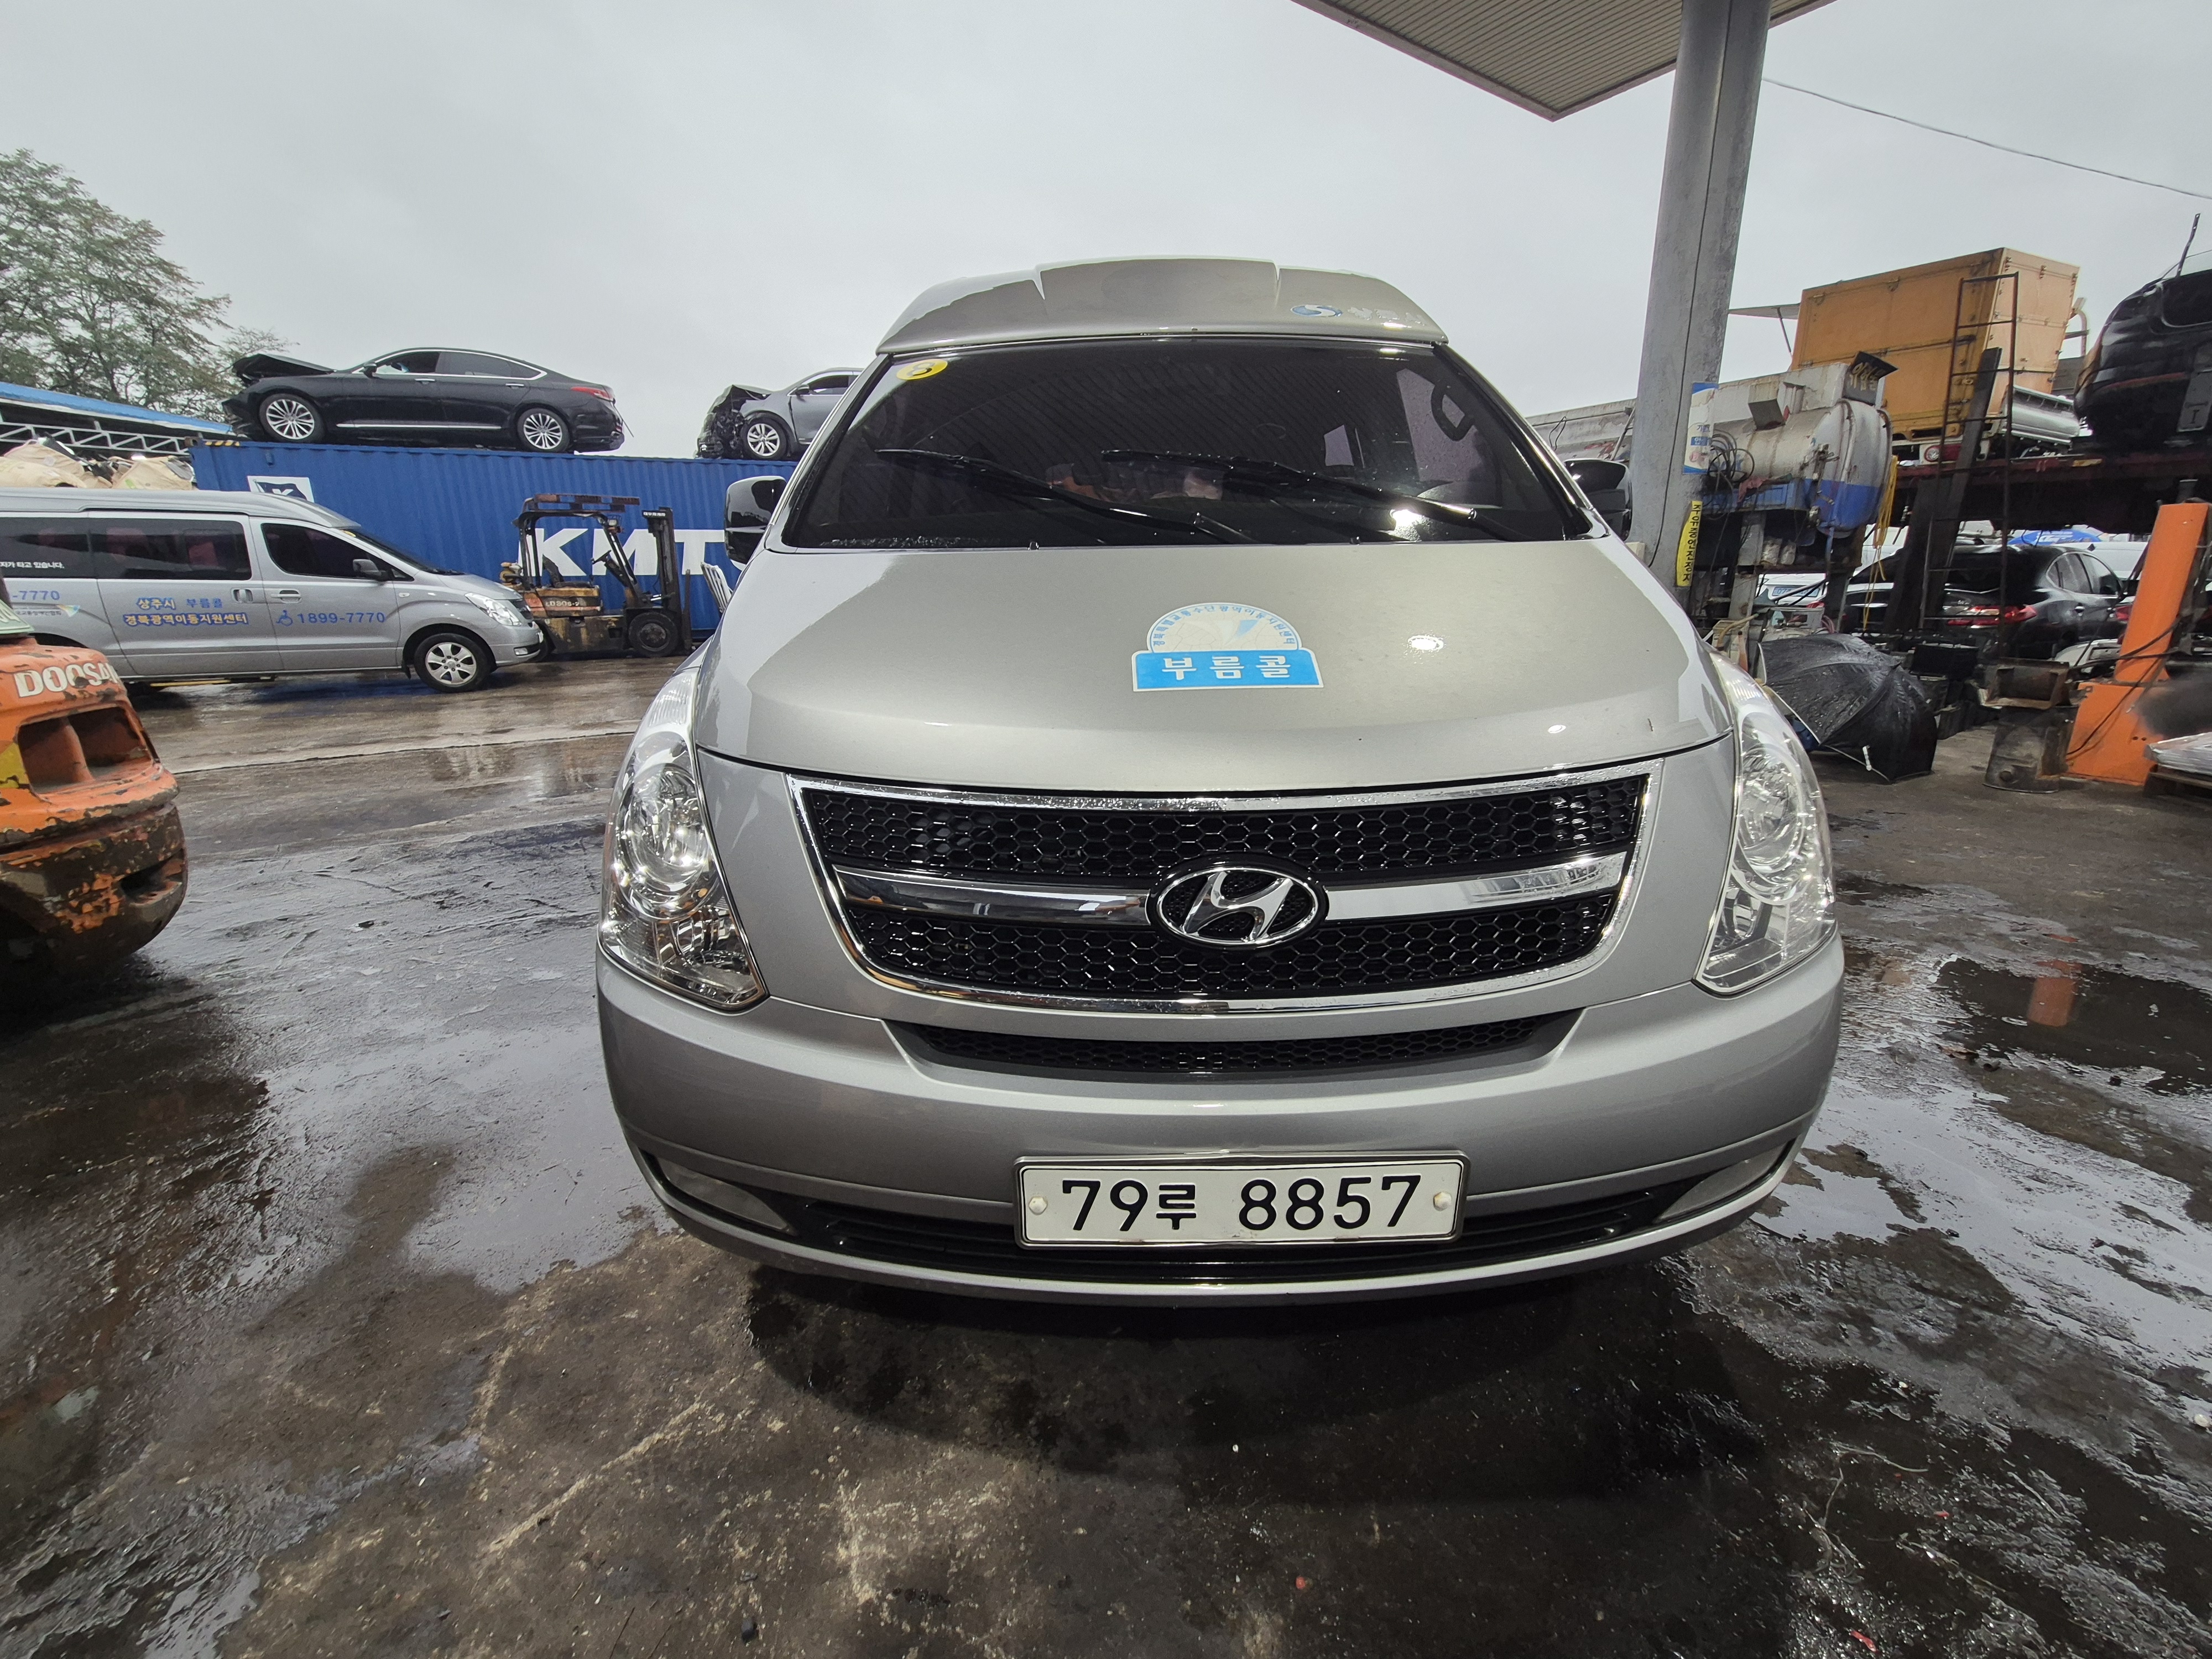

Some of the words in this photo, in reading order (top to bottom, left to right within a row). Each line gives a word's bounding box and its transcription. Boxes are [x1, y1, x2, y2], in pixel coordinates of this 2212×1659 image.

[518, 528, 745, 576] KMT
[137, 597, 176, 610] 상주시
[123, 612, 249, 627] 경북광역이동지원센터
[297, 612, 385, 624] 1899-7770
[1161, 655, 1291, 680] 부름콜
[1062, 1179, 1197, 1232] 79루
[1239, 1174, 1422, 1231] 8857
